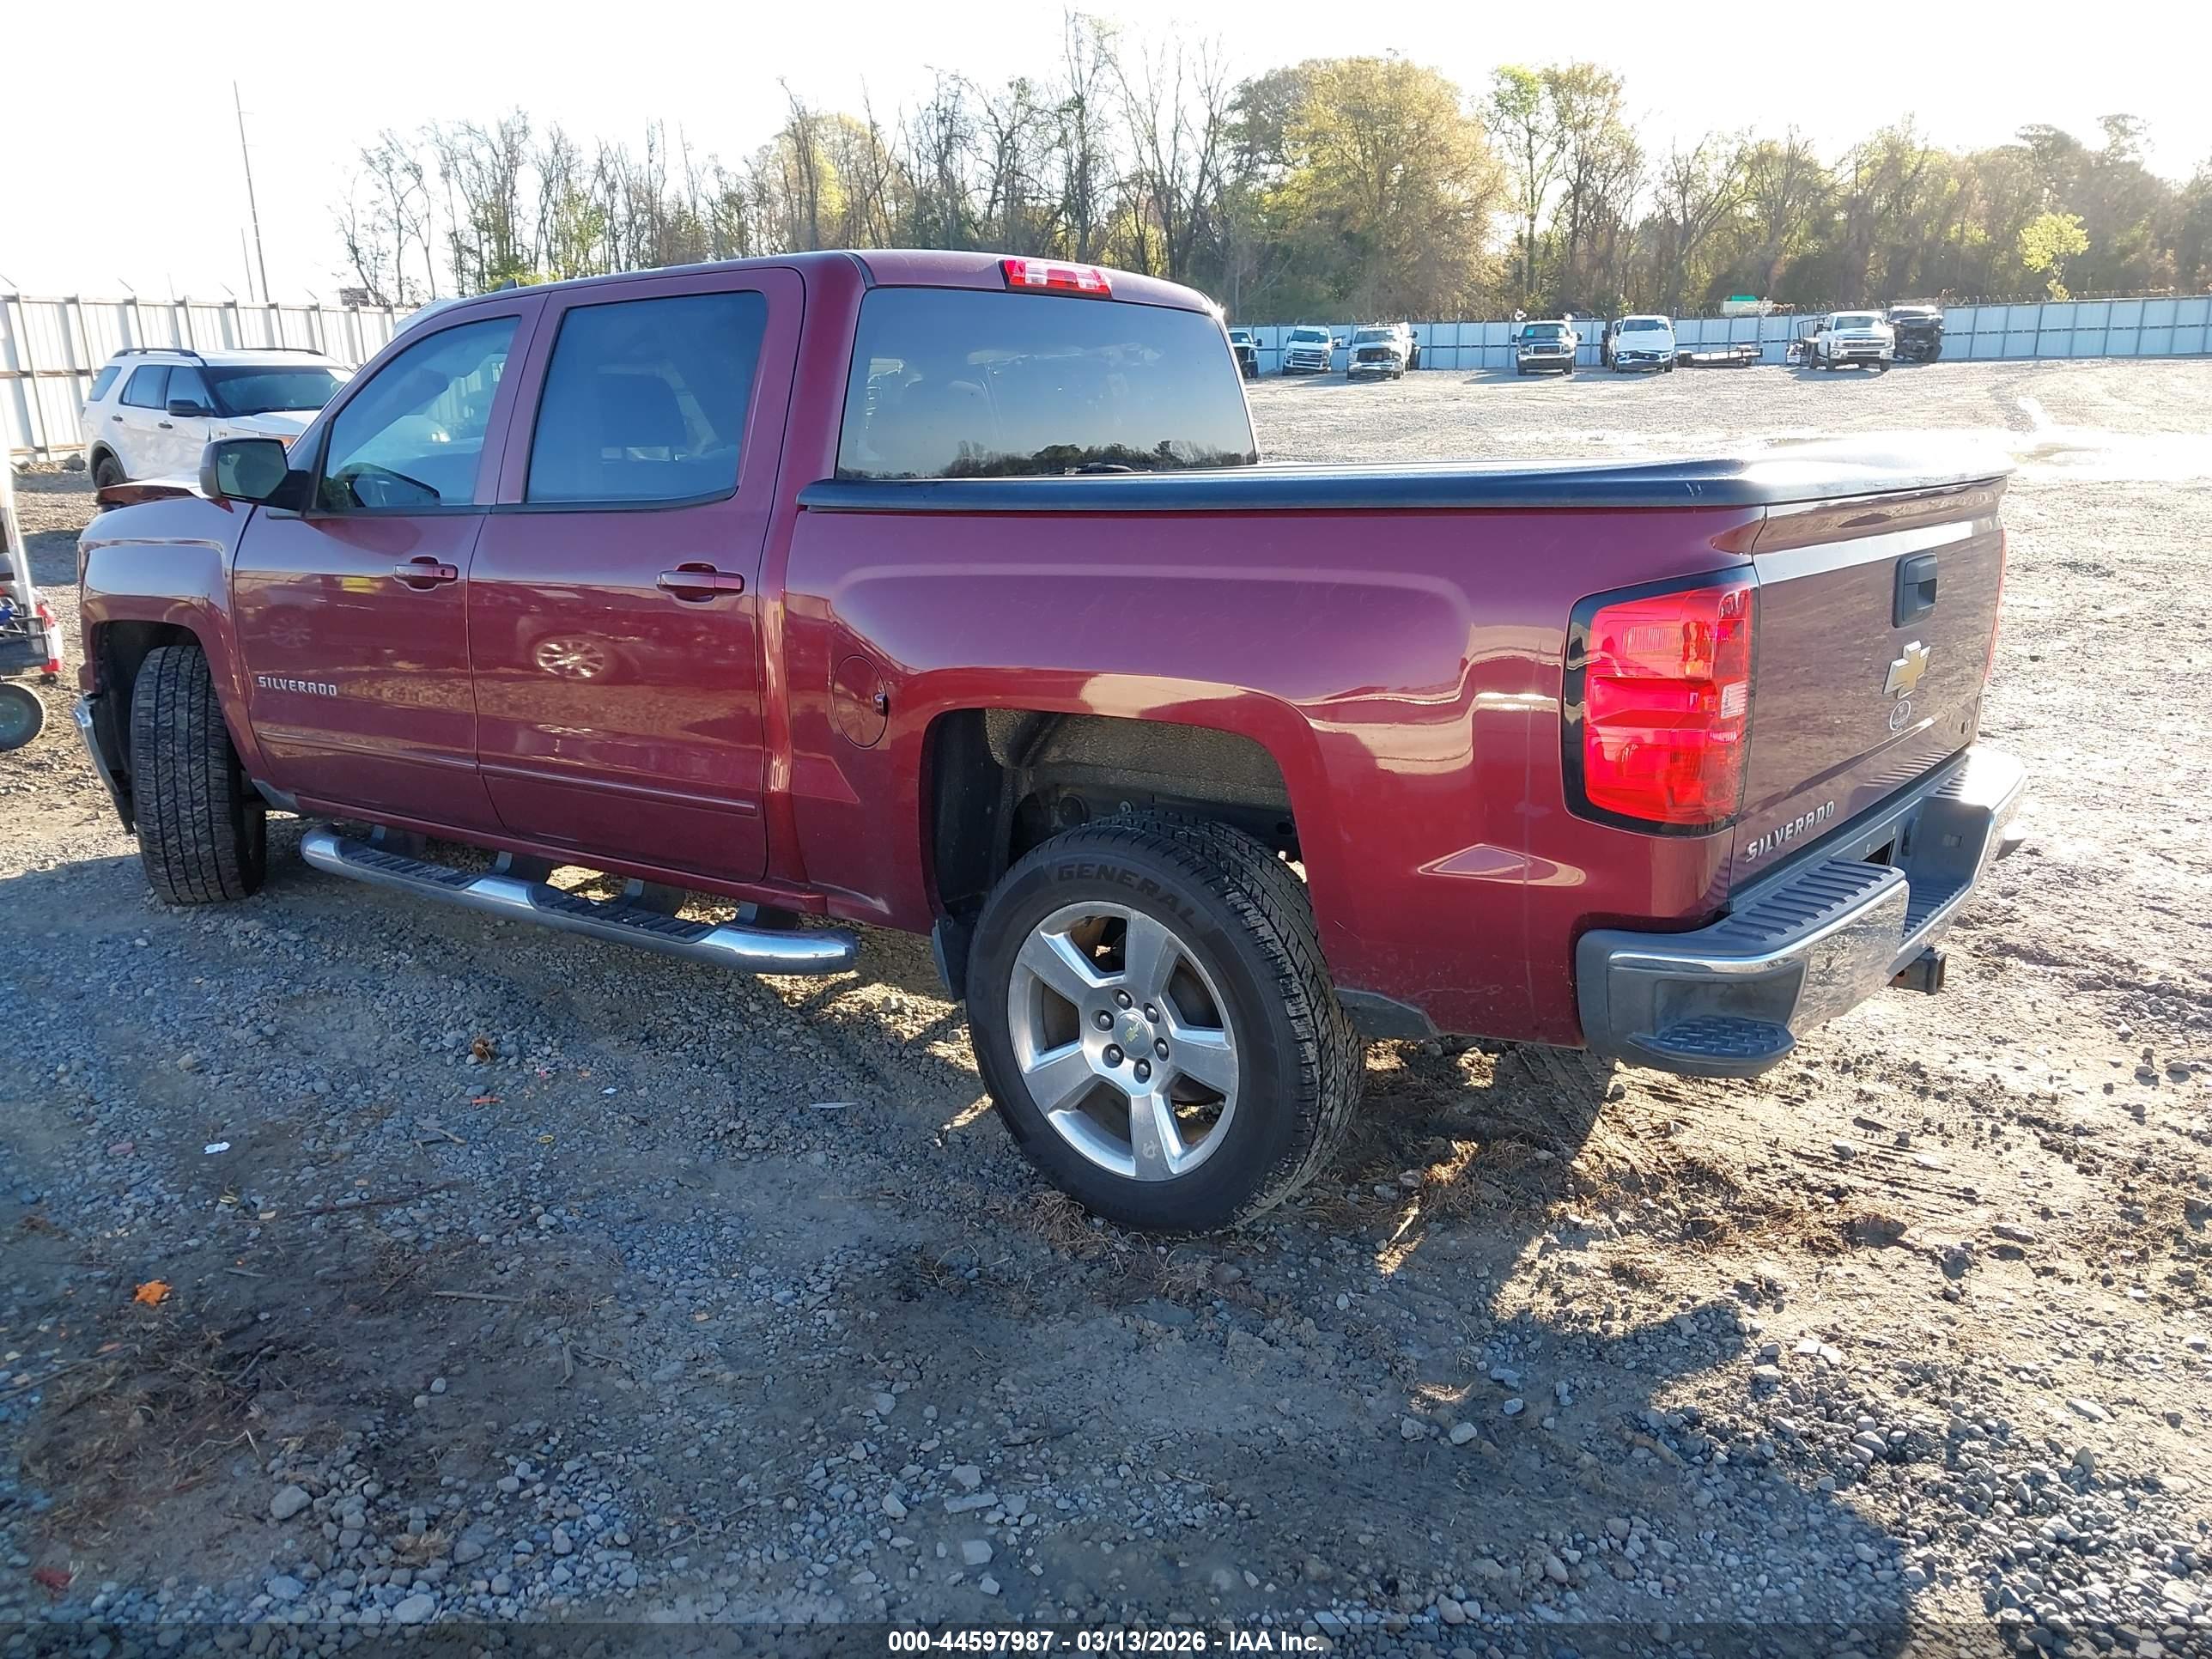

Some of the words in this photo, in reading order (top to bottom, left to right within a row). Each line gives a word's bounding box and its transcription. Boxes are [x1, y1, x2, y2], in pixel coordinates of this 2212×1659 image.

[258, 676, 337, 696] SILVERADO
[1745, 799, 1835, 863] SILVERADO
[1056, 863, 1196, 930] GENERAL
